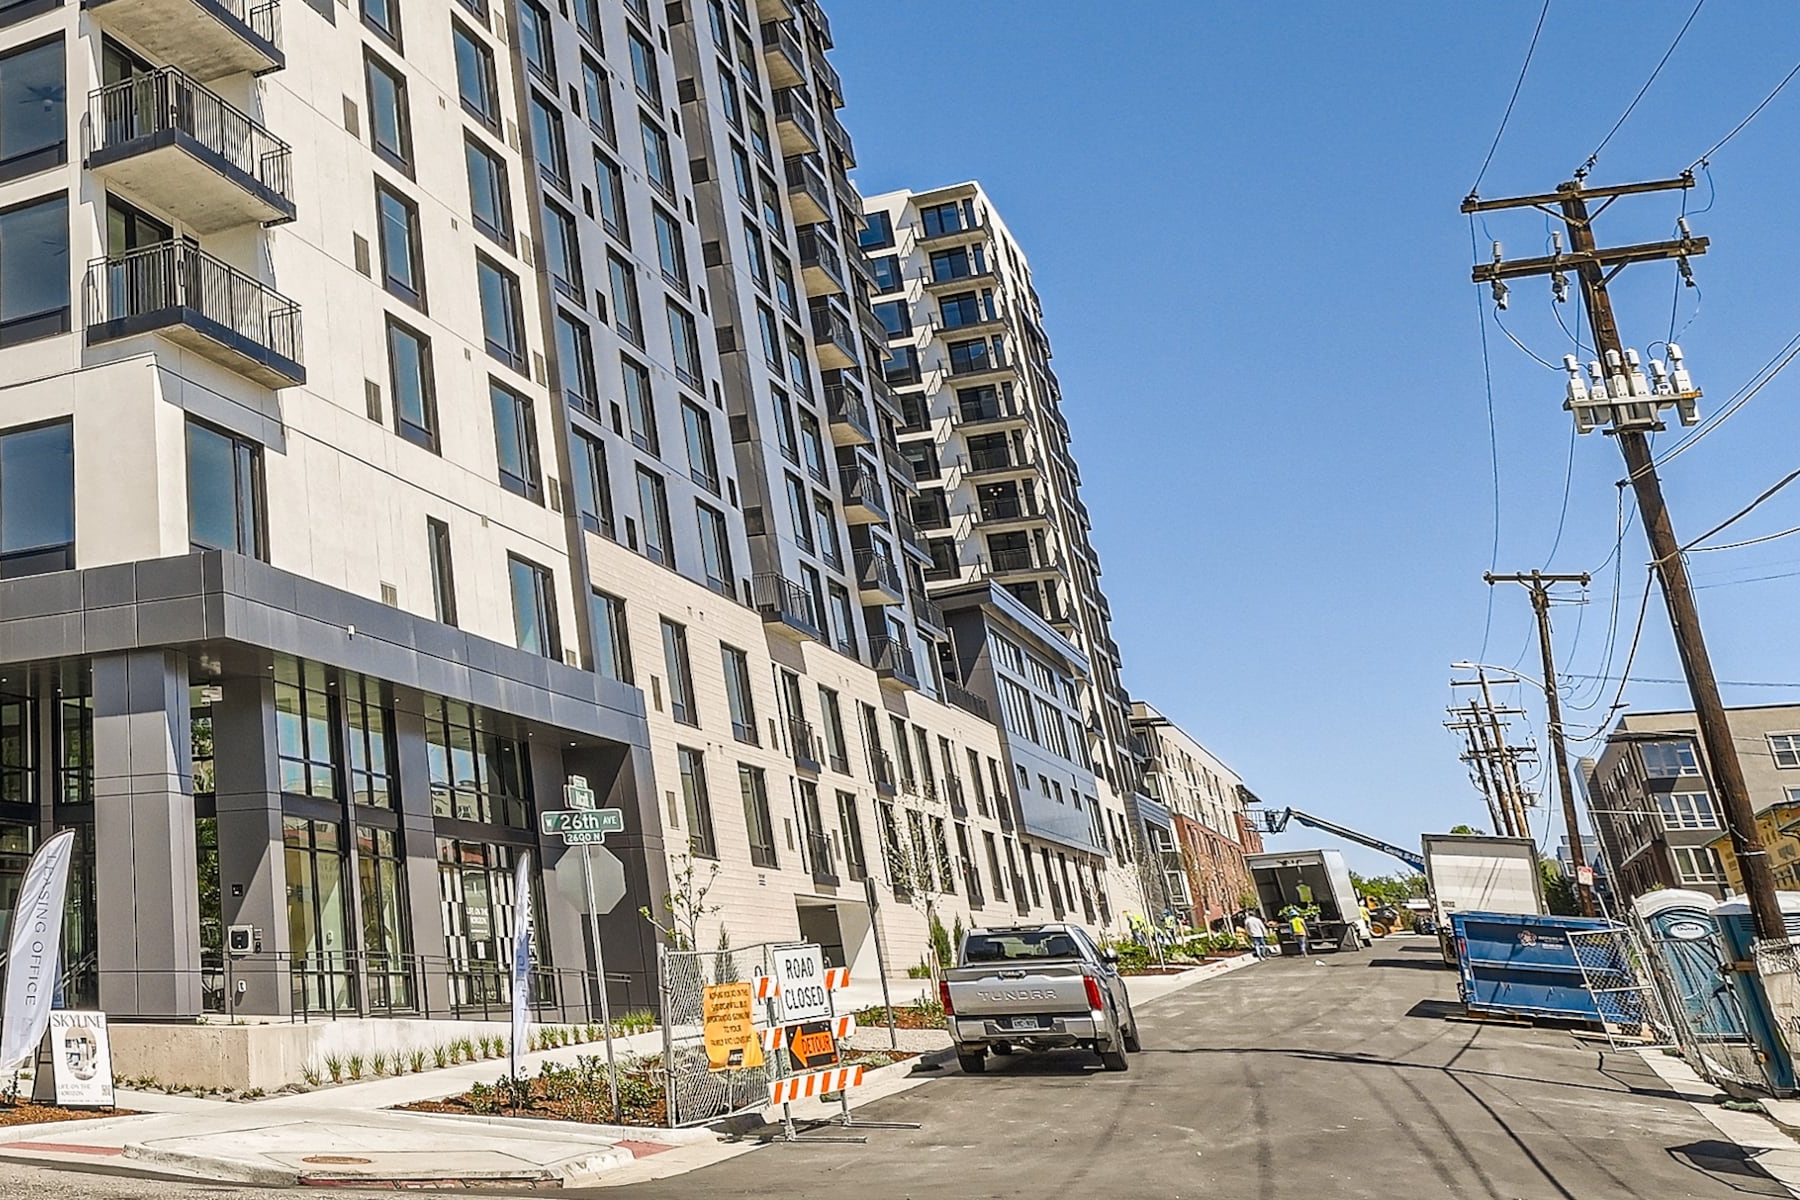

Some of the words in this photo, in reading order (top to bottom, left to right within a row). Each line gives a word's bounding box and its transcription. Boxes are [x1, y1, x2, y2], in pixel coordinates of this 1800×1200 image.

[560, 813, 600, 830] 26th
[602, 815, 617, 825] AVE
[567, 833, 592, 842] 2600
[593, 832, 600, 841] N
[34, 854, 57, 933] LEASING
[24, 941, 43, 1006] OFFICE
[785, 957, 815, 979] ROAD
[785, 985, 825, 1010] CLOSED
[976, 989, 1058, 1002] TUNDRA
[52, 1013, 104, 1029] SKYLINE
[801, 1034, 832, 1055] DETOUR
